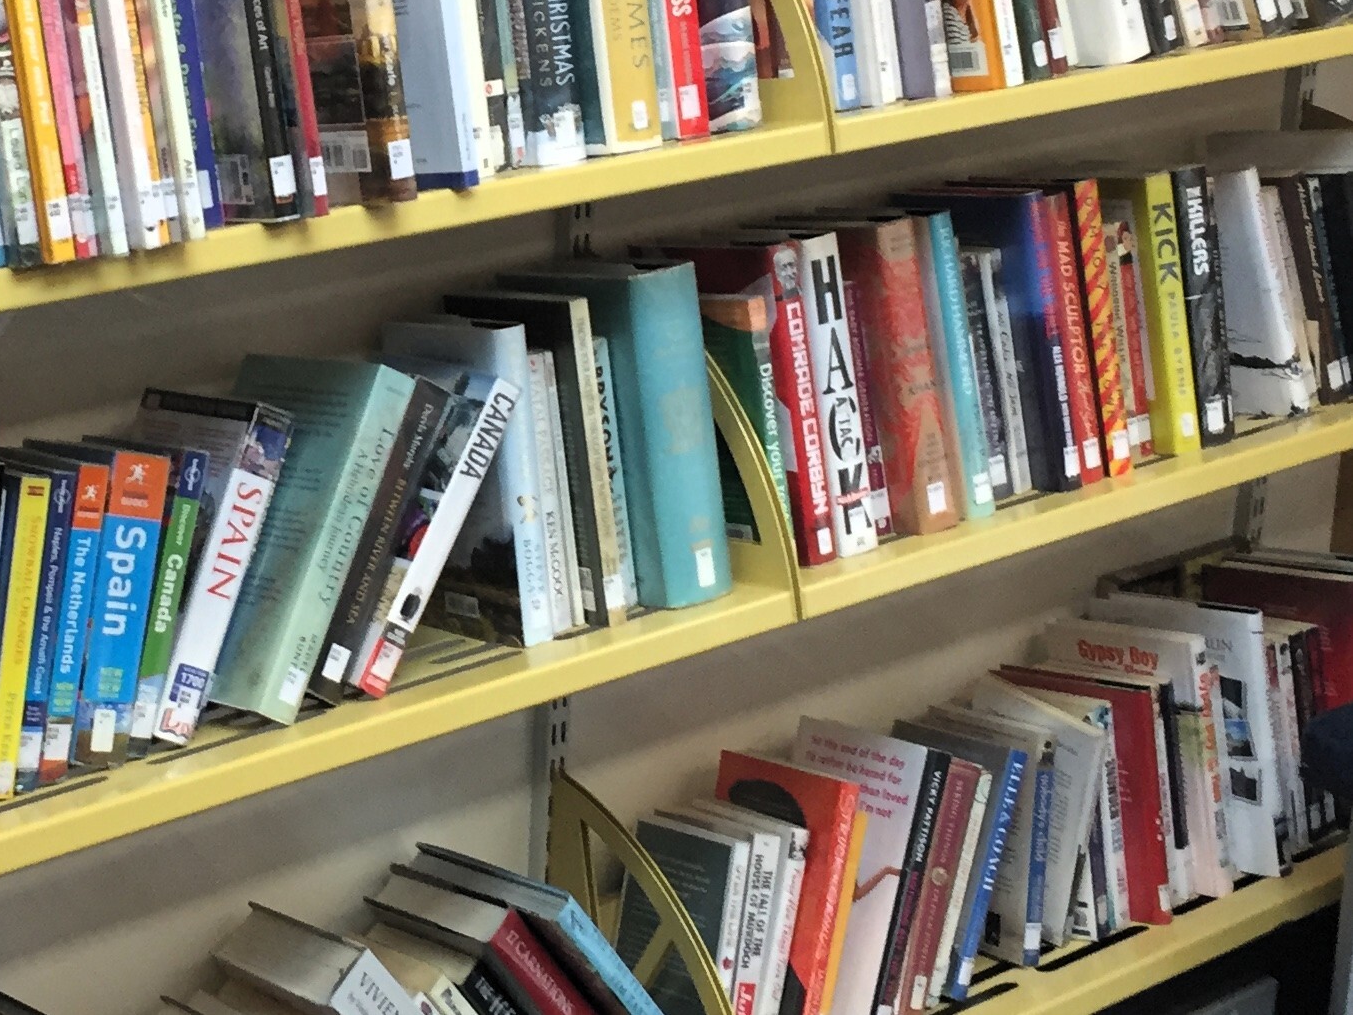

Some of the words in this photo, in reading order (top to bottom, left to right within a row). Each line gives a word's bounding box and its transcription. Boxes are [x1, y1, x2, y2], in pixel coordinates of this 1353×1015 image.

[1055, 239, 1074, 277] MAD
[1151, 201, 1179, 285] KICK
[1186, 197, 1210, 277] KILLERS
[784, 300, 817, 416] COMRADE
[1062, 279, 1088, 374] SCULPTOR
[364, 426, 395, 478] Love
[458, 388, 518, 484] CANADA
[800, 416, 831, 516] CORBYN
[72, 534, 93, 568] The
[93, 521, 149, 639] Spain
[204, 479, 265, 601] SPAIN
[314, 511, 364, 609] Country
[57, 569, 89, 675] Netherlands
[1077, 639, 1124, 665] Gypsy
[926, 769, 944, 806] VICKY
[913, 805, 936, 863] PATTISON
[740, 910, 757, 970] MURDOCH
